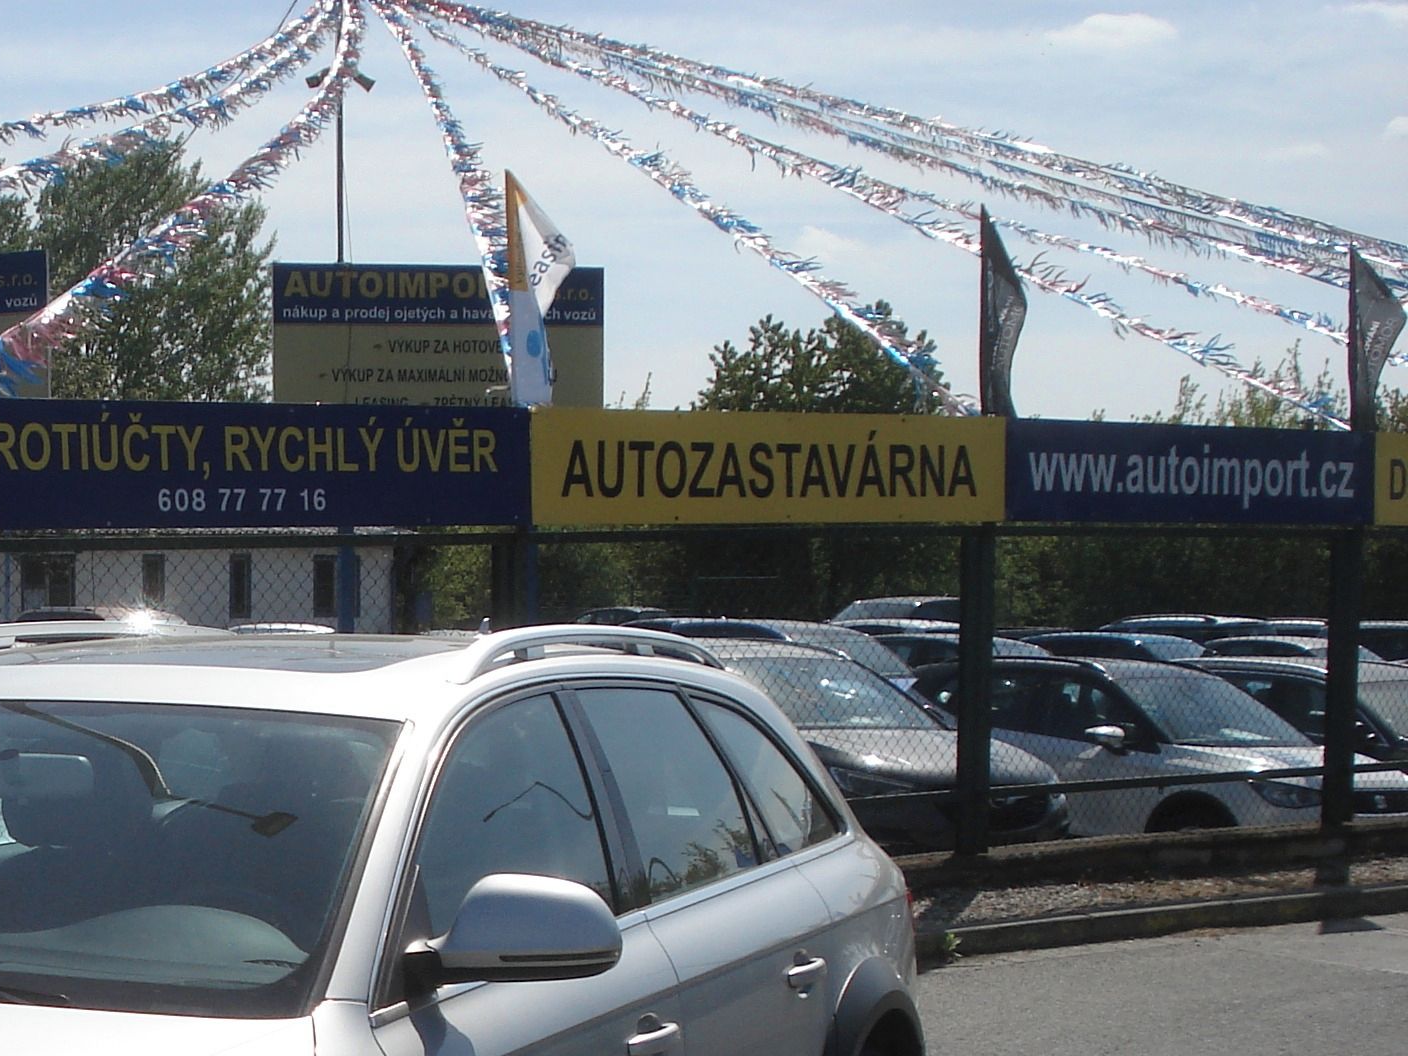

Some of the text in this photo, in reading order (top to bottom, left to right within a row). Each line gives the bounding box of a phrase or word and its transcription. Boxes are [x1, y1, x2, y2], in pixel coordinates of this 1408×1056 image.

[283, 305, 327, 320] nákup
[332, 310, 340, 318] a
[345, 306, 390, 322] prodej
[394, 307, 445, 322] ojetých
[450, 311, 458, 319] a
[564, 308, 596, 321] vozů
[388, 338, 430, 353] VÝKUP
[434, 340, 449, 354] ZA
[332, 366, 374, 382] VÝKUP
[377, 369, 394, 382] ZA
[398, 365, 465, 382] MAXIMÁLNÍ
[223, 416, 384, 472] RYCHLÝ
[397, 416, 498, 473] ÚVĚR
[561, 430, 977, 498] AUTOZASTAVÁRNA
[1029, 443, 1355, 509] www.autoimport.cz
[158, 488, 327, 512] 608 77 77 16
